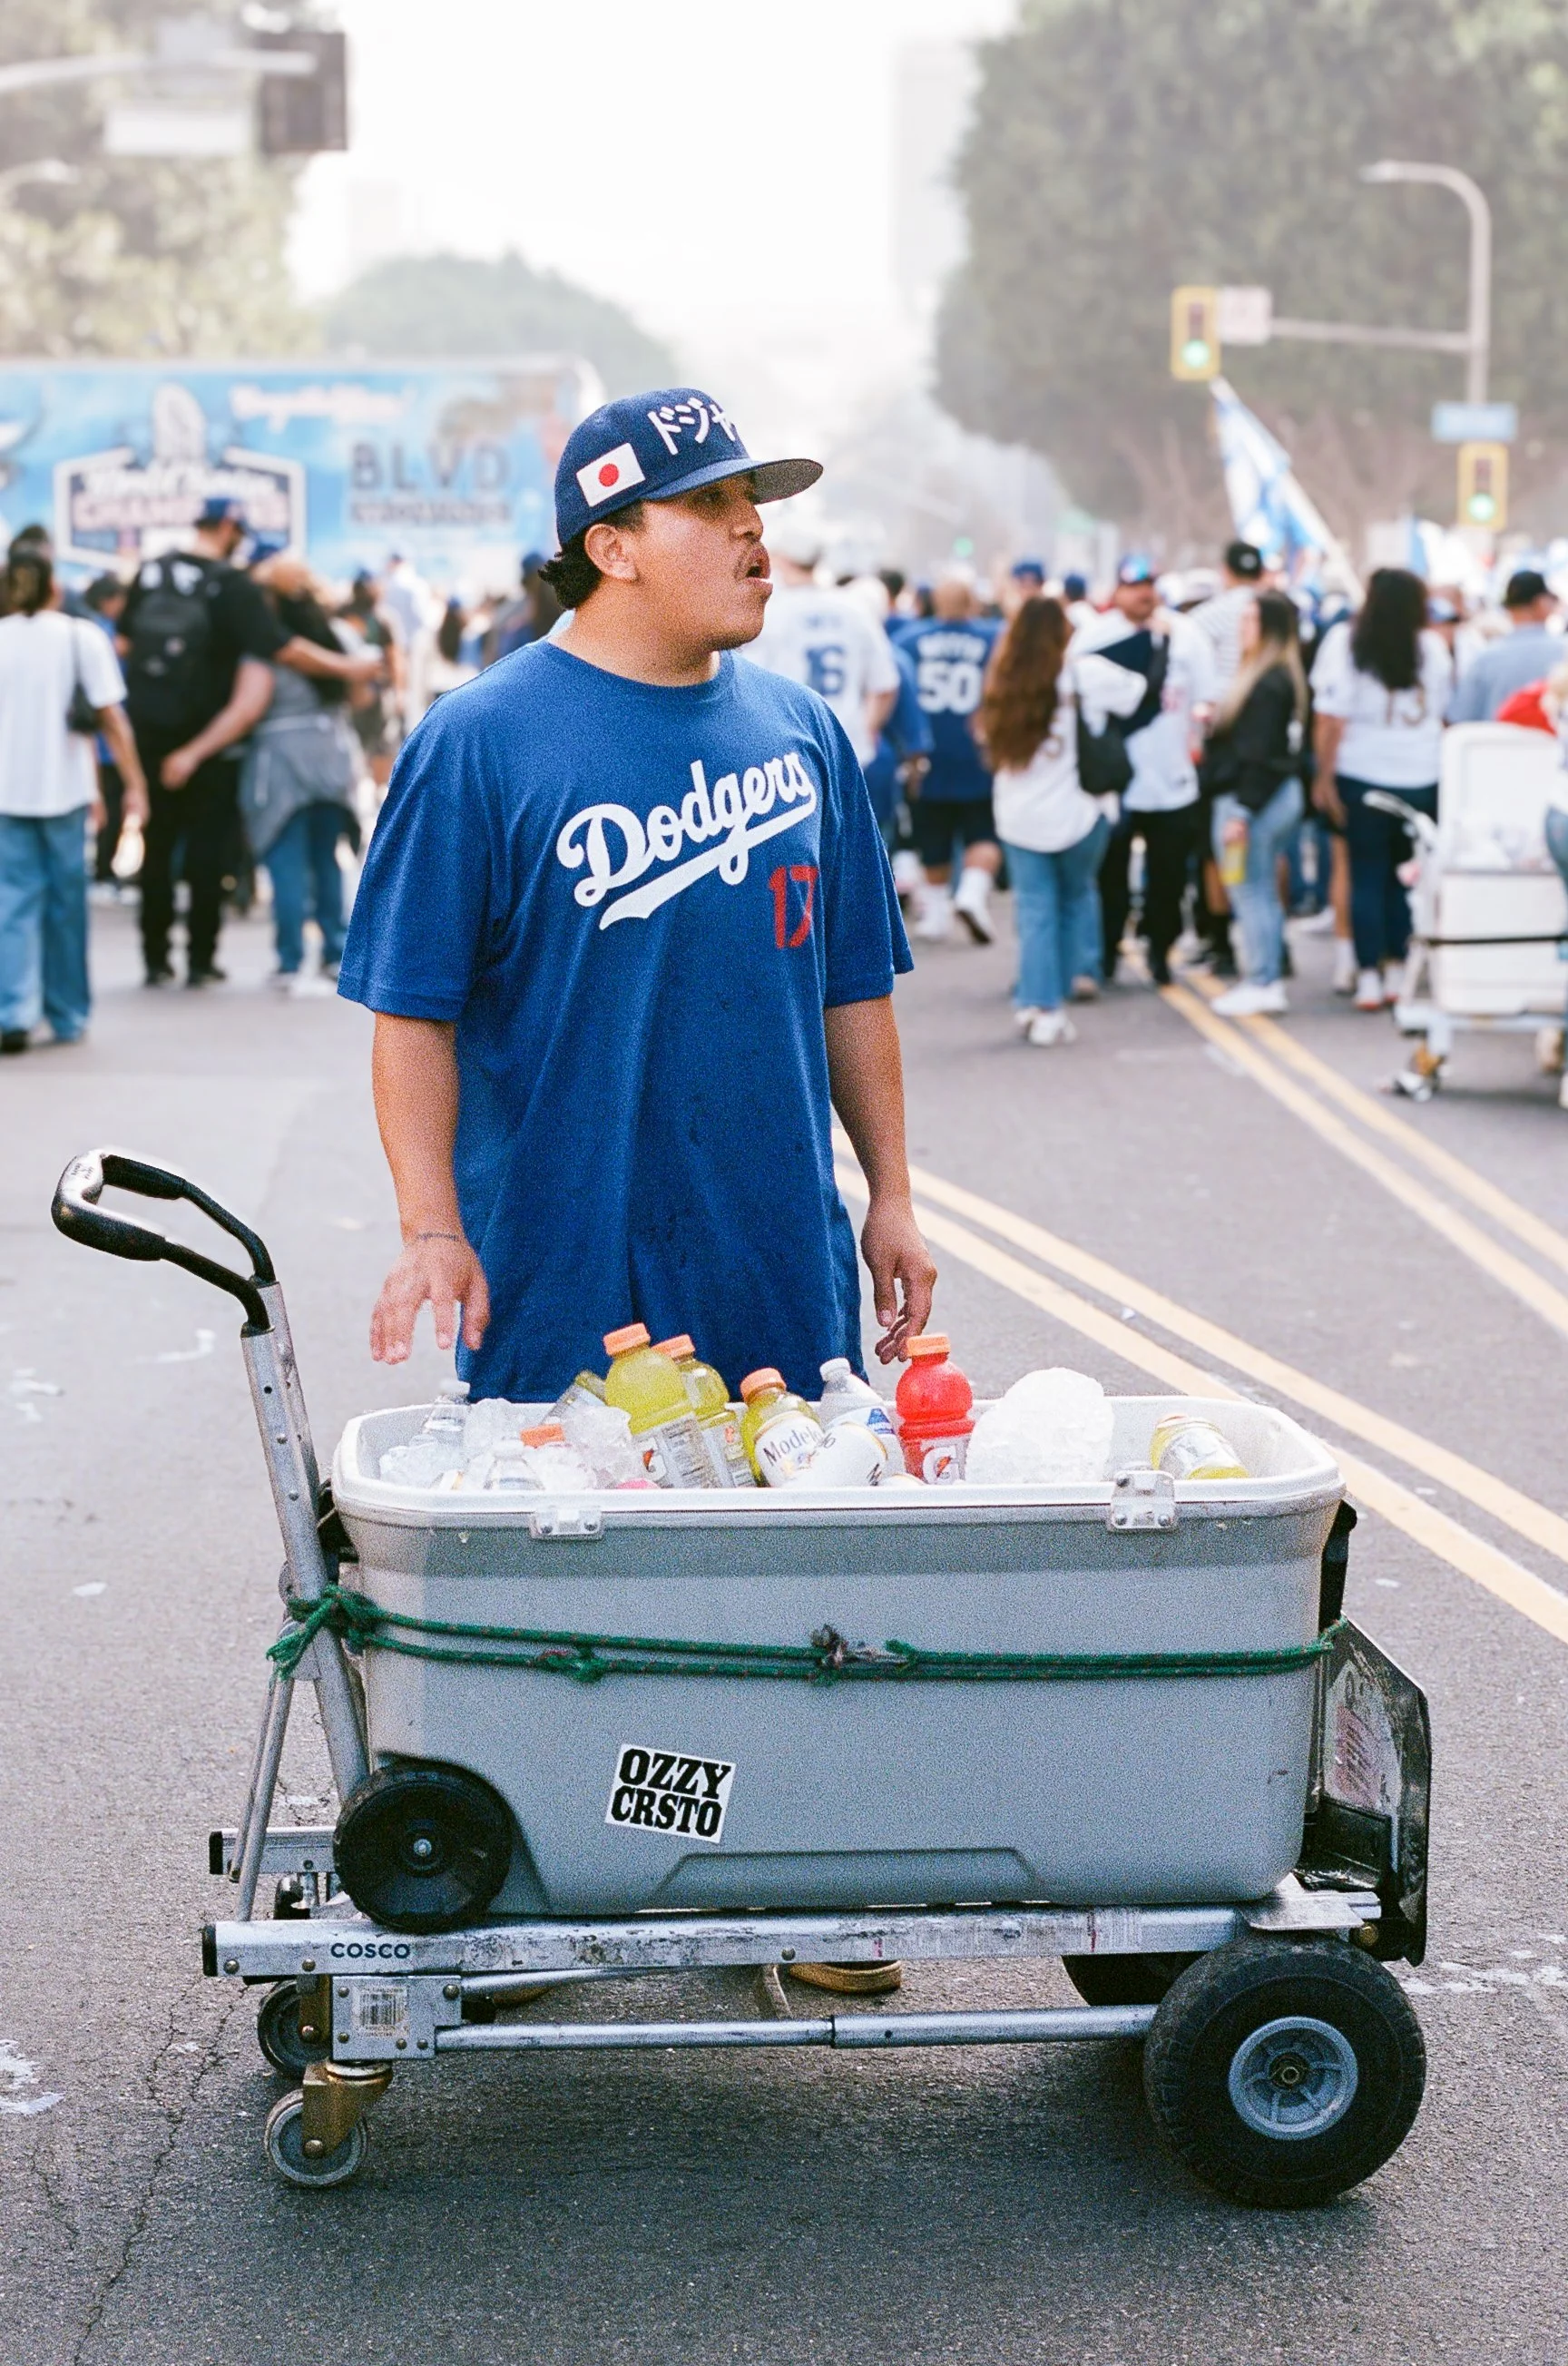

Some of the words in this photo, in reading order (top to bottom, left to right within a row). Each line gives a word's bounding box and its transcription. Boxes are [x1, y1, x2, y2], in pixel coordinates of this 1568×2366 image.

[351, 442, 512, 491] BLVD
[916, 662, 983, 715] 50
[556, 751, 817, 930] Dodgers
[769, 864, 818, 950] 17
[619, 1748, 731, 1800] OZZY
[611, 1784, 722, 1838] CRSTO
[330, 1942, 410, 1959] COSCO
